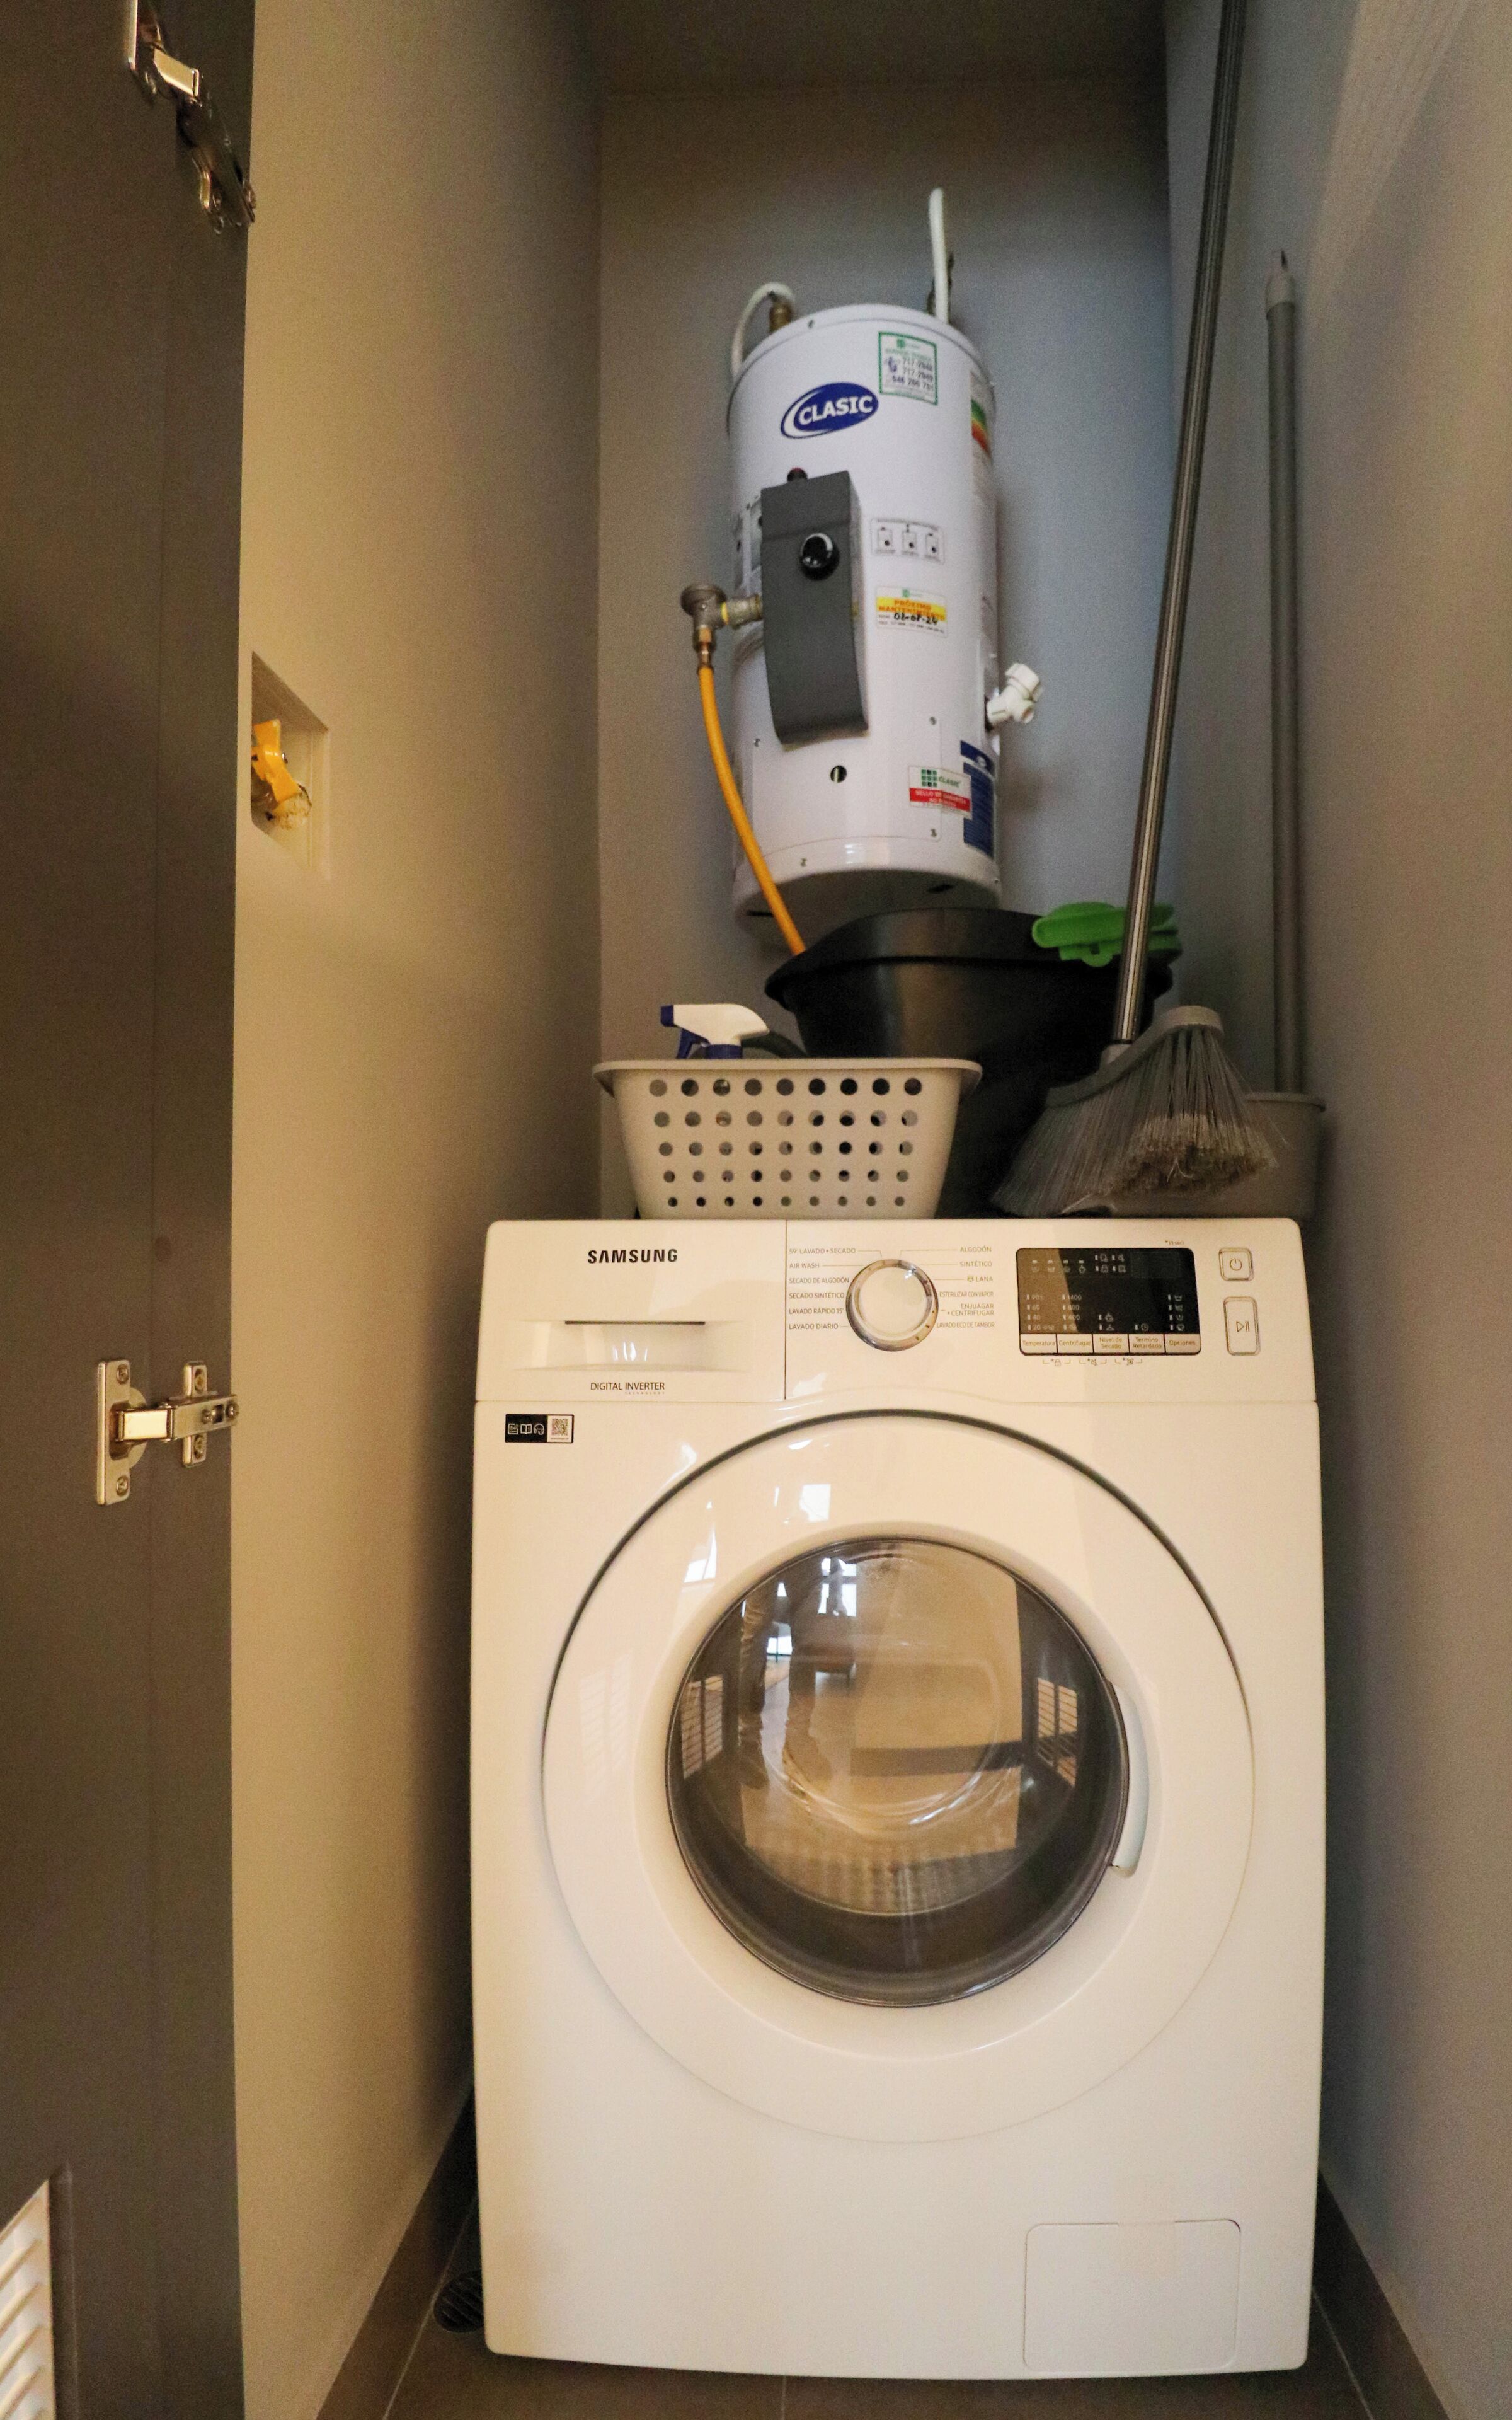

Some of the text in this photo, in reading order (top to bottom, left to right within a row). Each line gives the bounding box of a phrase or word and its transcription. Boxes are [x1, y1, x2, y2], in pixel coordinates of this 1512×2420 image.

[799, 395, 873, 425] CLASIC
[587, 1248, 678, 1264] SAMSUNG
[590, 1382, 665, 1390] DIGITAL INVERTER
